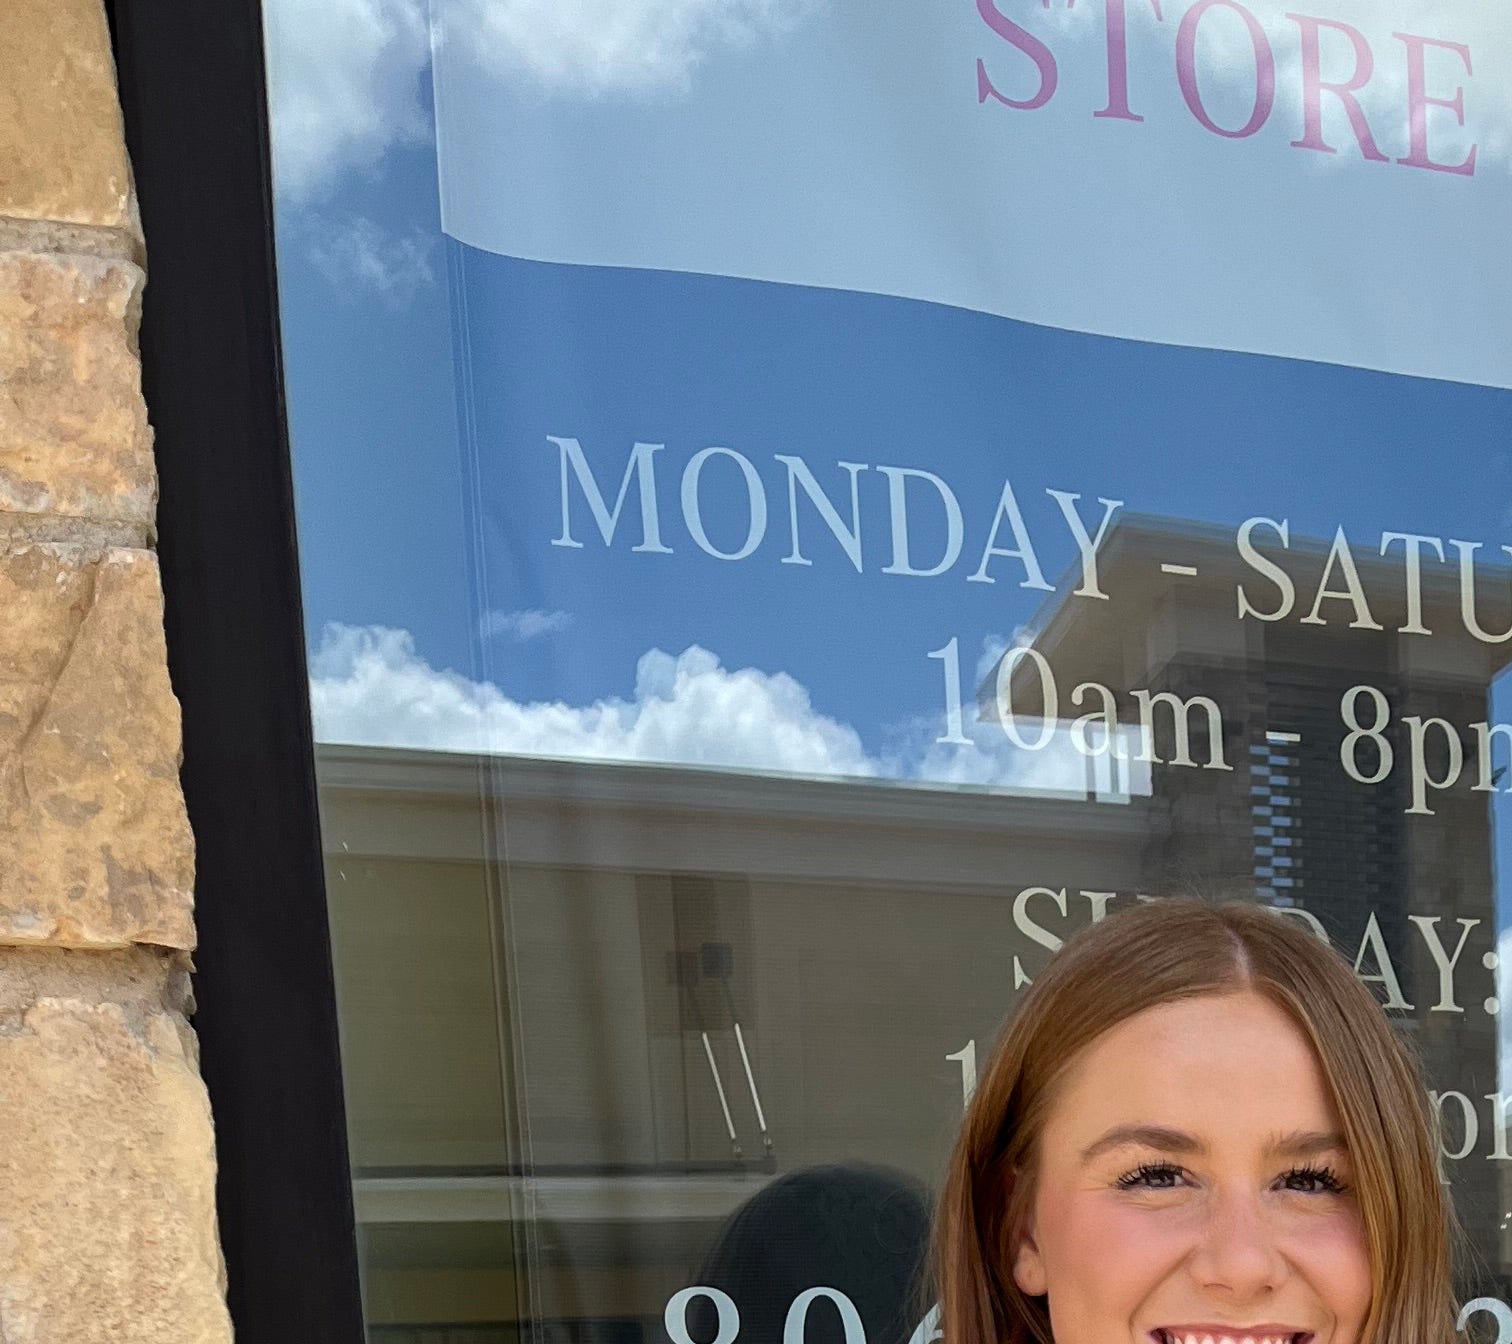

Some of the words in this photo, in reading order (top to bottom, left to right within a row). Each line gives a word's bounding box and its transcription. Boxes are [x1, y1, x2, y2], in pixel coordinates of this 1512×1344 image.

[975, 0, 1477, 177] STORE
[546, 435, 1124, 600] MONDAY
[927, 636, 1233, 771] 10am
